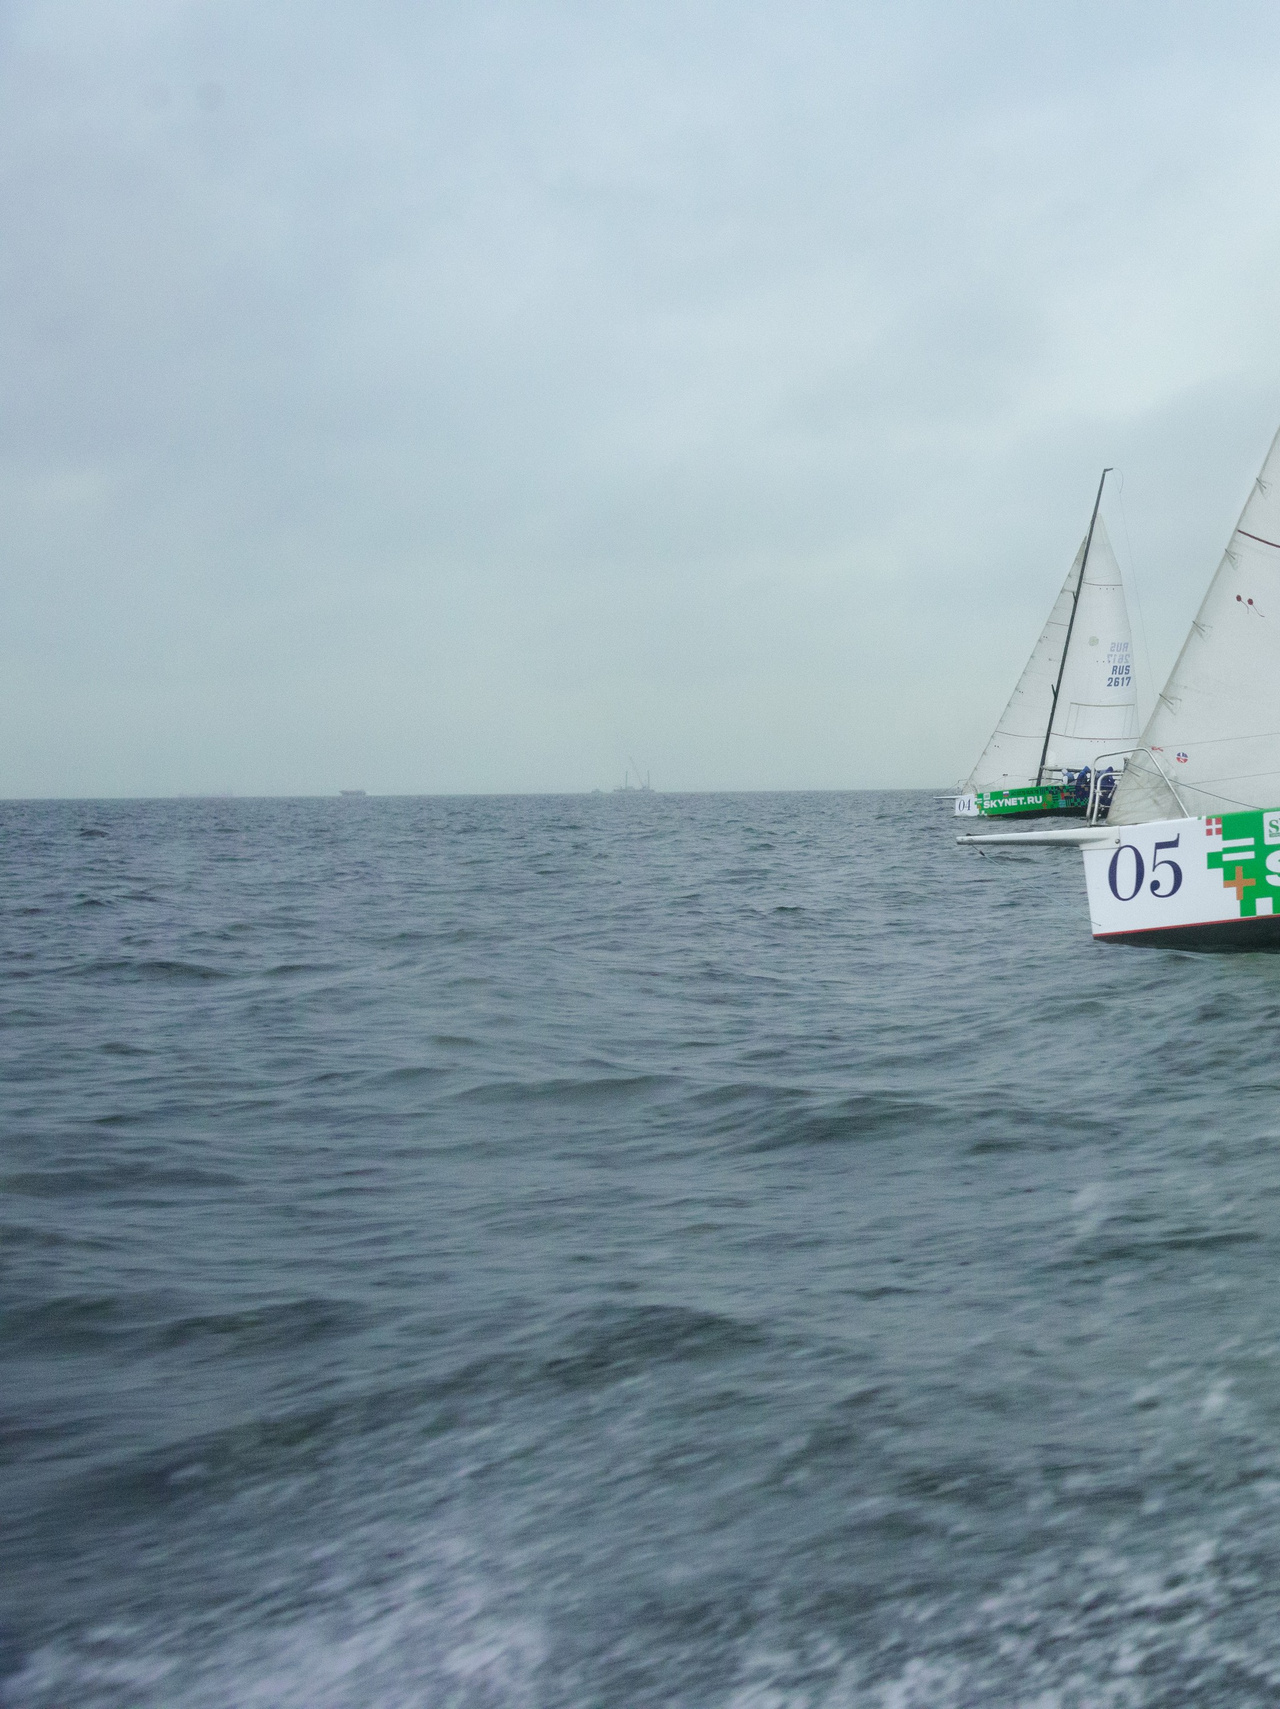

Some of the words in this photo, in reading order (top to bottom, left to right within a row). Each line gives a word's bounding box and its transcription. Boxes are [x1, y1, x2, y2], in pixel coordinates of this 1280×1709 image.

[1112, 665, 1130, 675] RUS
[1107, 676, 1131, 687] 2617
[959, 799, 971, 811] 04
[983, 795, 1043, 809] SKYNET.RU
[1108, 833, 1183, 901] 05
